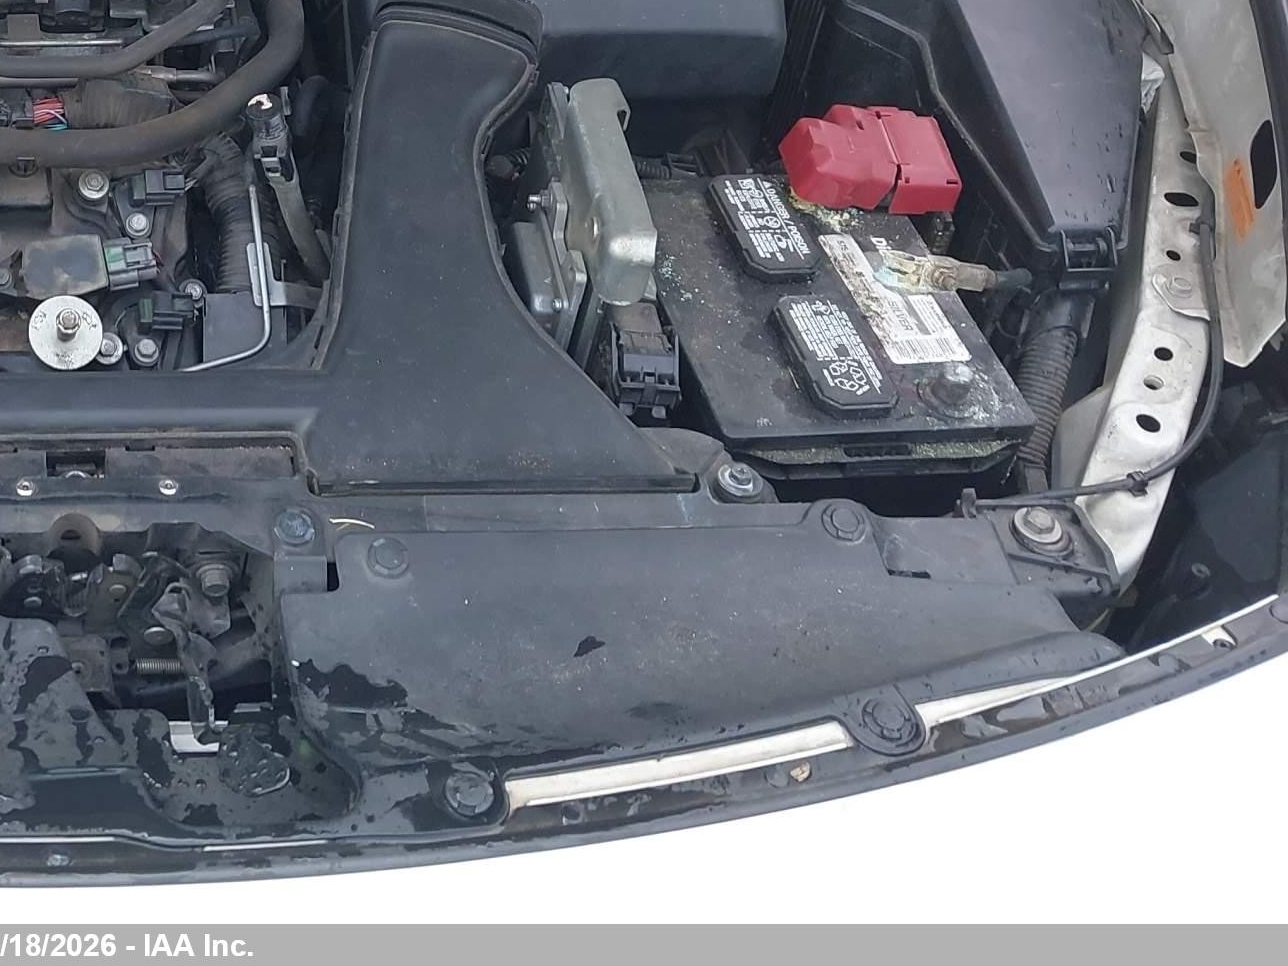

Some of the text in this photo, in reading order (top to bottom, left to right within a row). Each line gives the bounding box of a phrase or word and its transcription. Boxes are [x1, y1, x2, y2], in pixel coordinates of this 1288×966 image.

[767, 188, 790, 220] DANGER
[788, 226, 811, 254] POISON
[888, 300, 914, 331] SILVER
